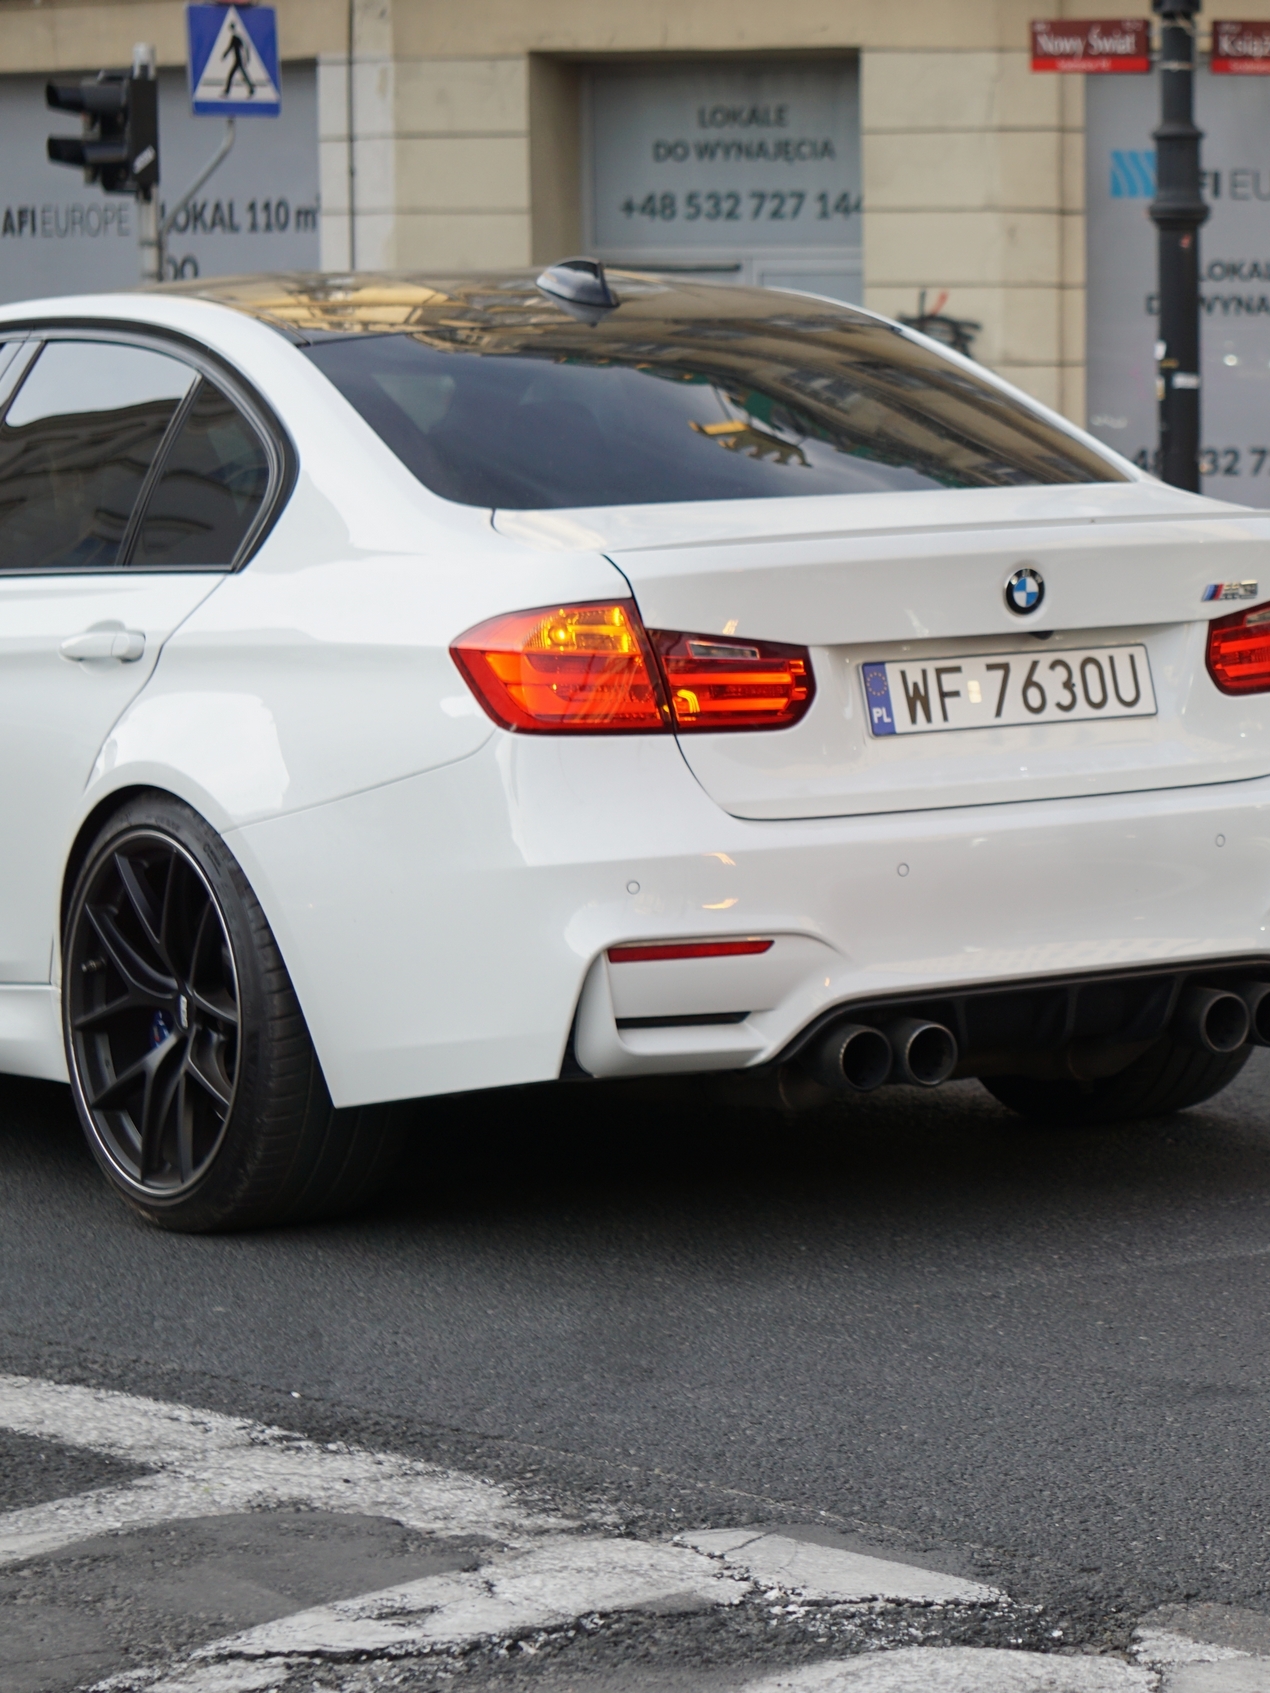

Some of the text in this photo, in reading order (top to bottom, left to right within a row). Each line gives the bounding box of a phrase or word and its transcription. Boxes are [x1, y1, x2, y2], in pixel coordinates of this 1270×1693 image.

[1037, 23, 1136, 61] Nowy Świat
[698, 106, 788, 129] LOKALE
[653, 140, 835, 164] DO WYNAJĘCIA
[2, 203, 130, 238] AFI EUROPE
[248, 199, 290, 232] 110
[622, 191, 676, 221] +48
[685, 192, 740, 221] 532
[750, 192, 804, 221] 727
[1200, 449, 1240, 475] 32
[872, 654, 1141, 725] PL WF 7630U
